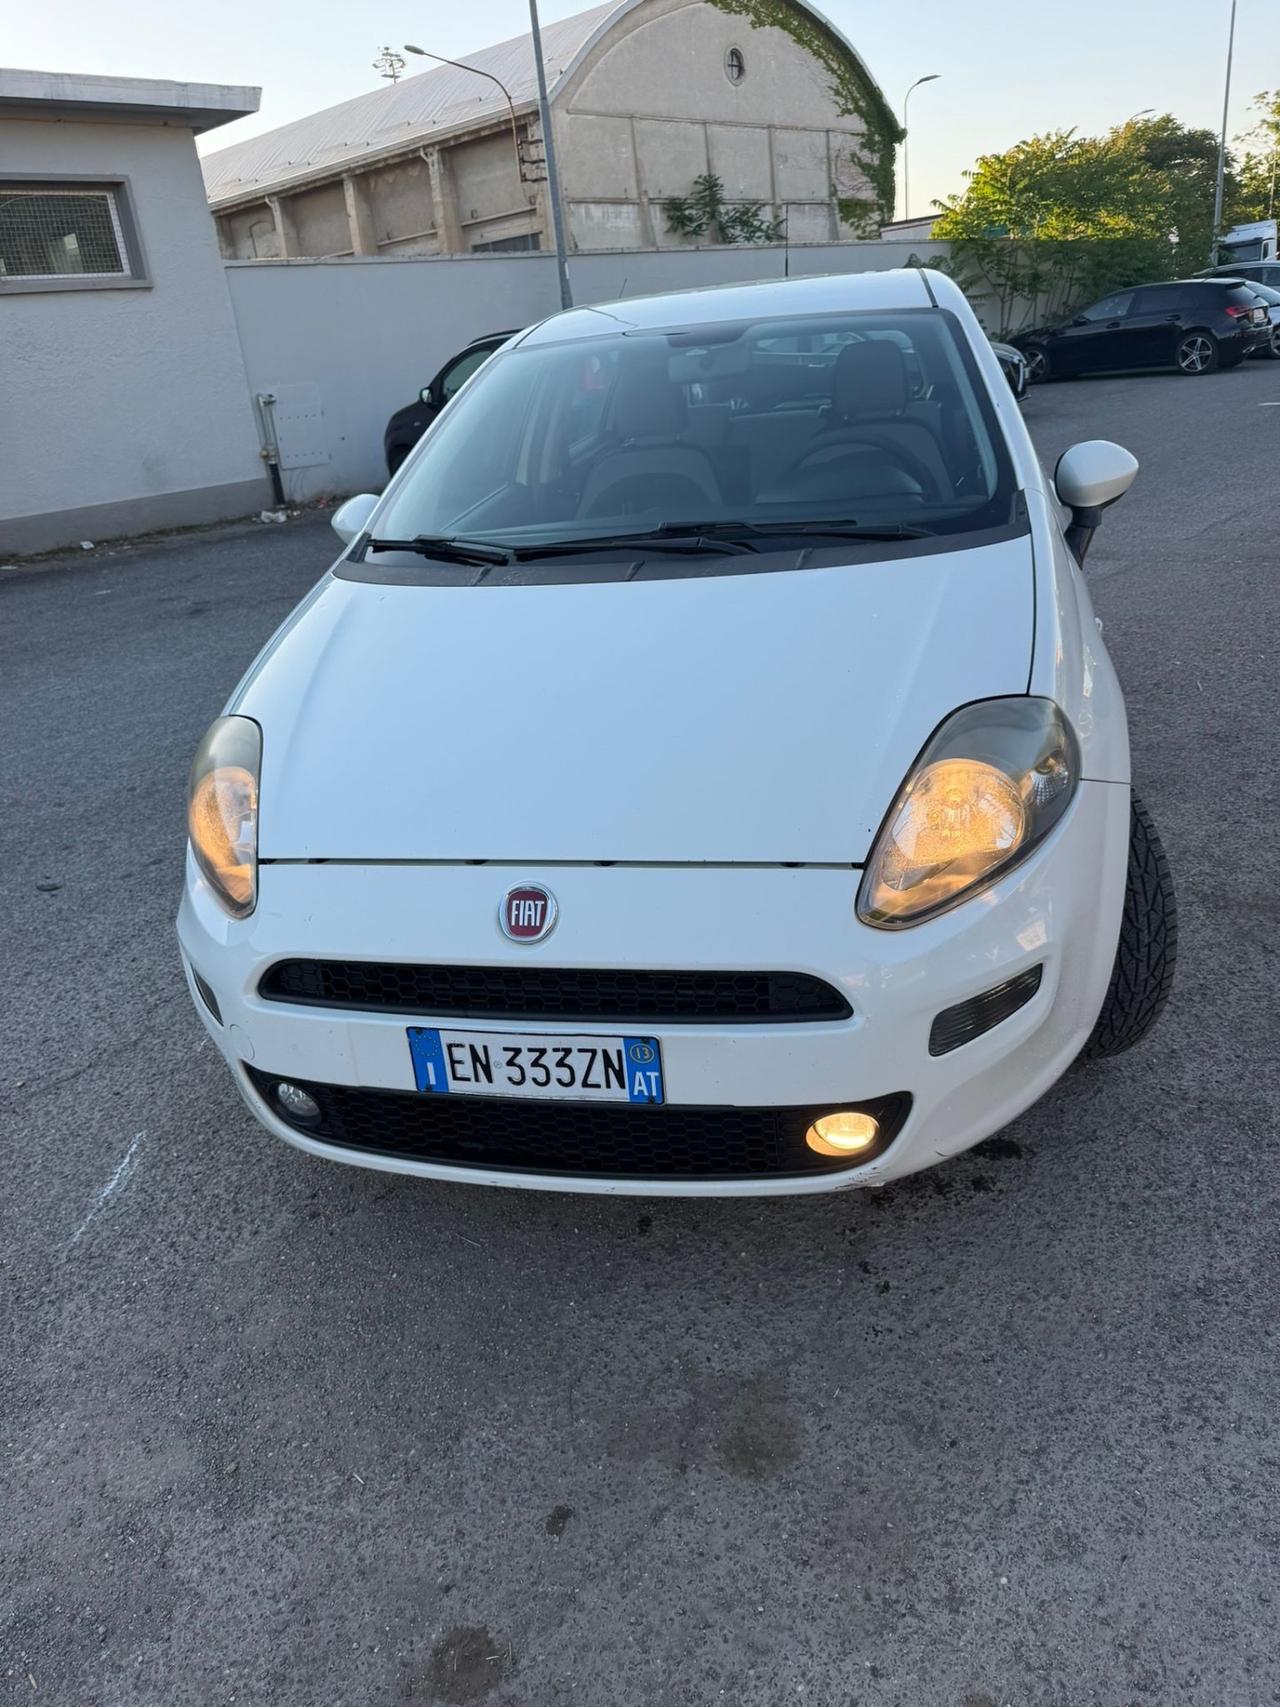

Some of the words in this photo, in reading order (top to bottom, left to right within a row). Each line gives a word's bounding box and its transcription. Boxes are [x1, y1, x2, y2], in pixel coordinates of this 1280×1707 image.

[511, 900, 545, 926] FIAT
[446, 1043, 493, 1084] EN
[502, 1046, 626, 1089] 333ZN
[634, 1047, 650, 1060] 13
[426, 1062, 436, 1085] I
[633, 1071, 659, 1096] AT
